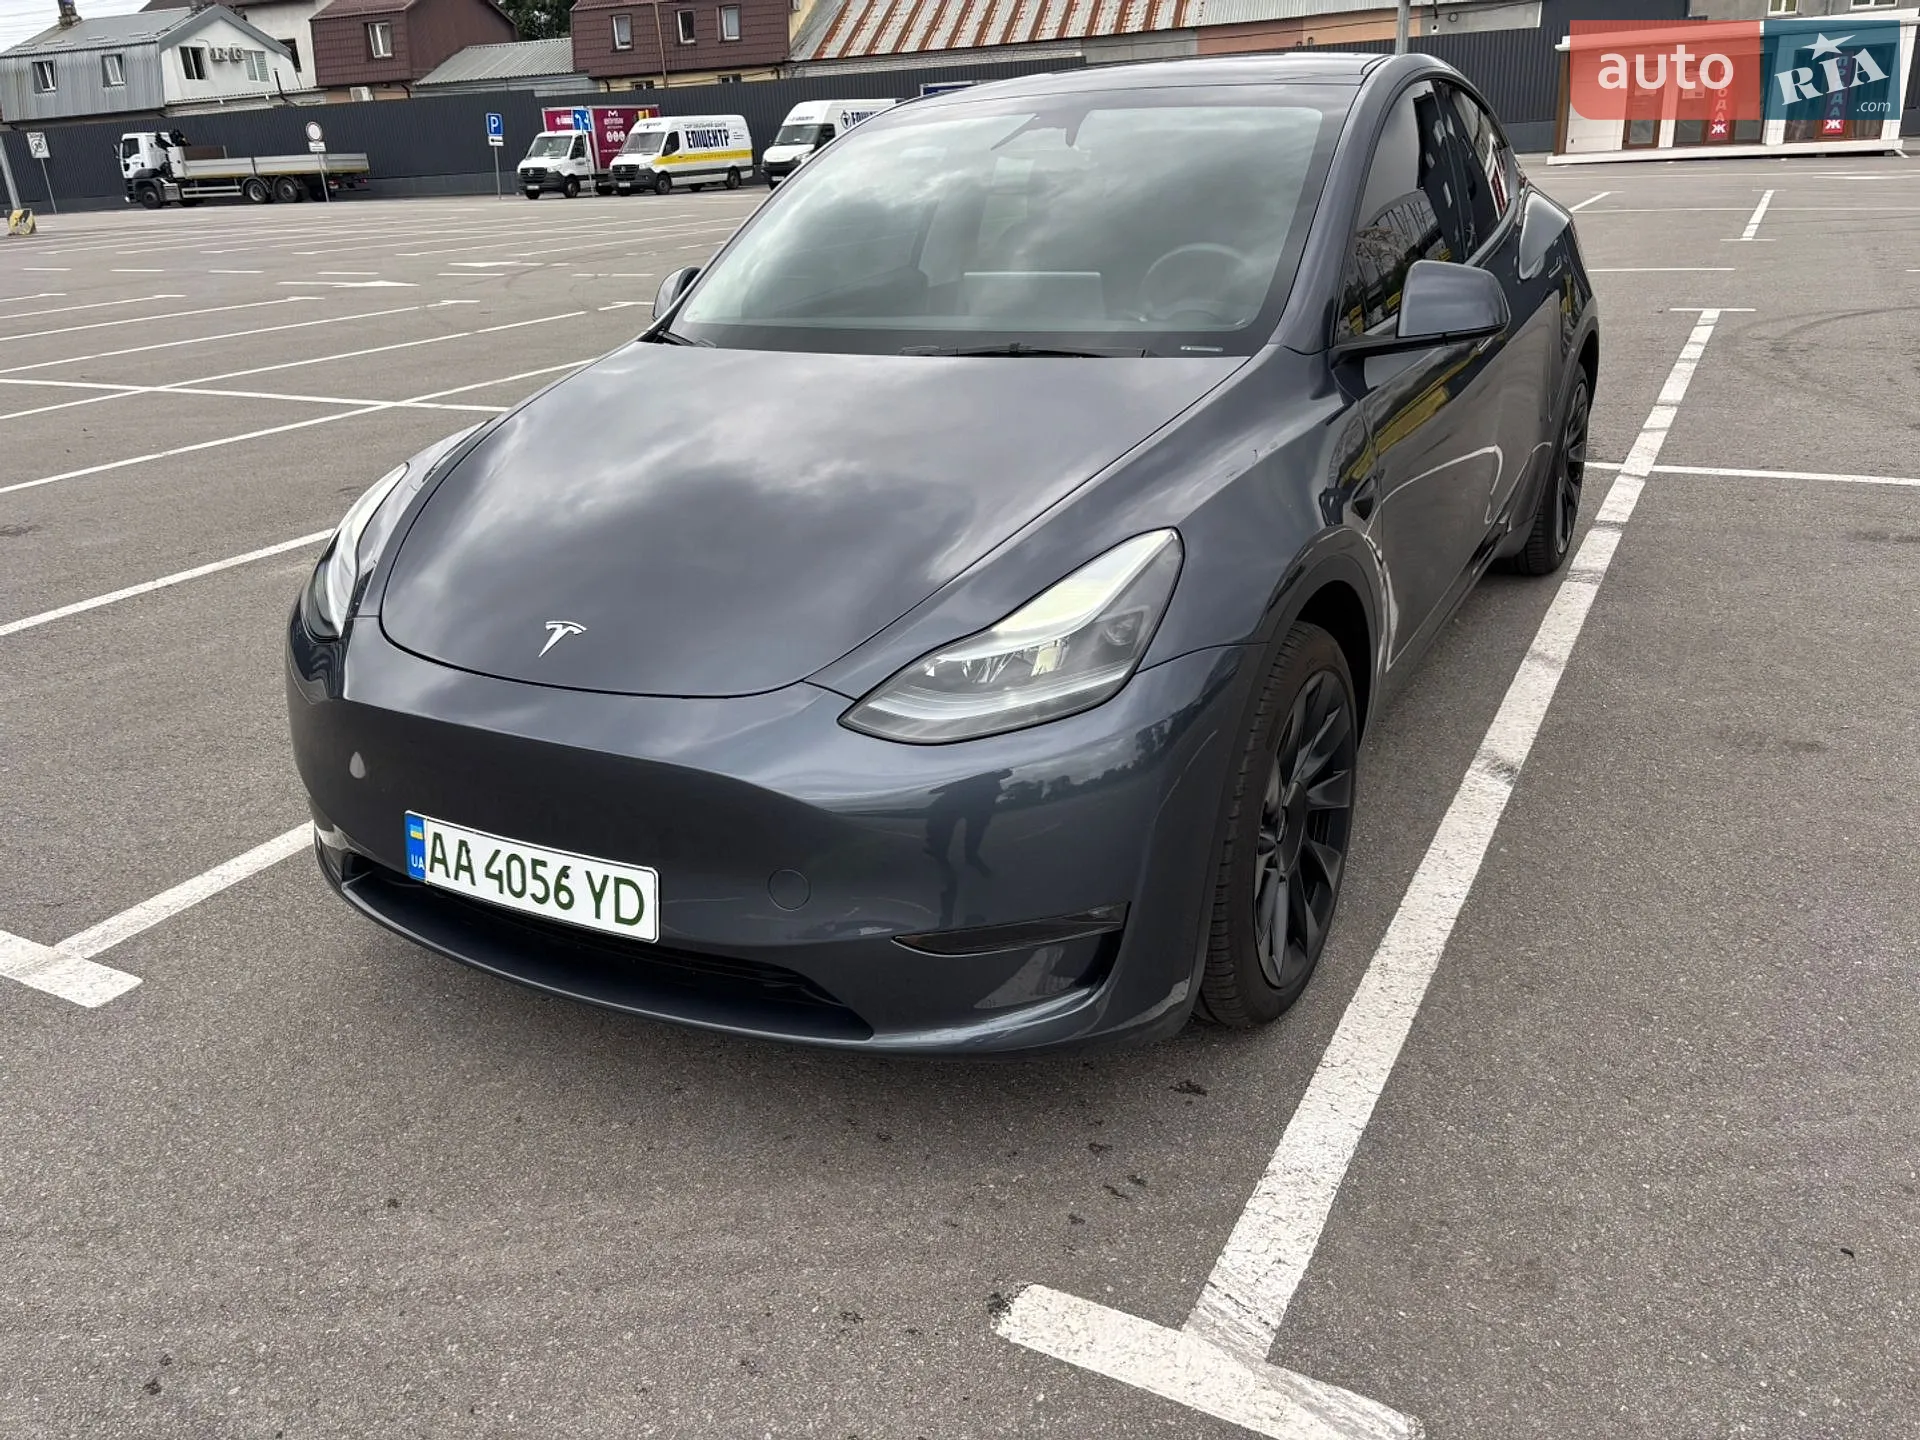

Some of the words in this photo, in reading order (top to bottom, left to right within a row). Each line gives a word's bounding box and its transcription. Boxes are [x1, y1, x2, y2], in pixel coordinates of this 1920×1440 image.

[1825, 55, 1849, 129] ПРДАЖ
[490, 116, 499, 133] P
[685, 129, 730, 149] ЕПІЦЕНТР
[411, 854, 425, 870] UA
[429, 832, 476, 886] AA
[484, 849, 575, 911] 4056
[585, 871, 645, 926] YD
